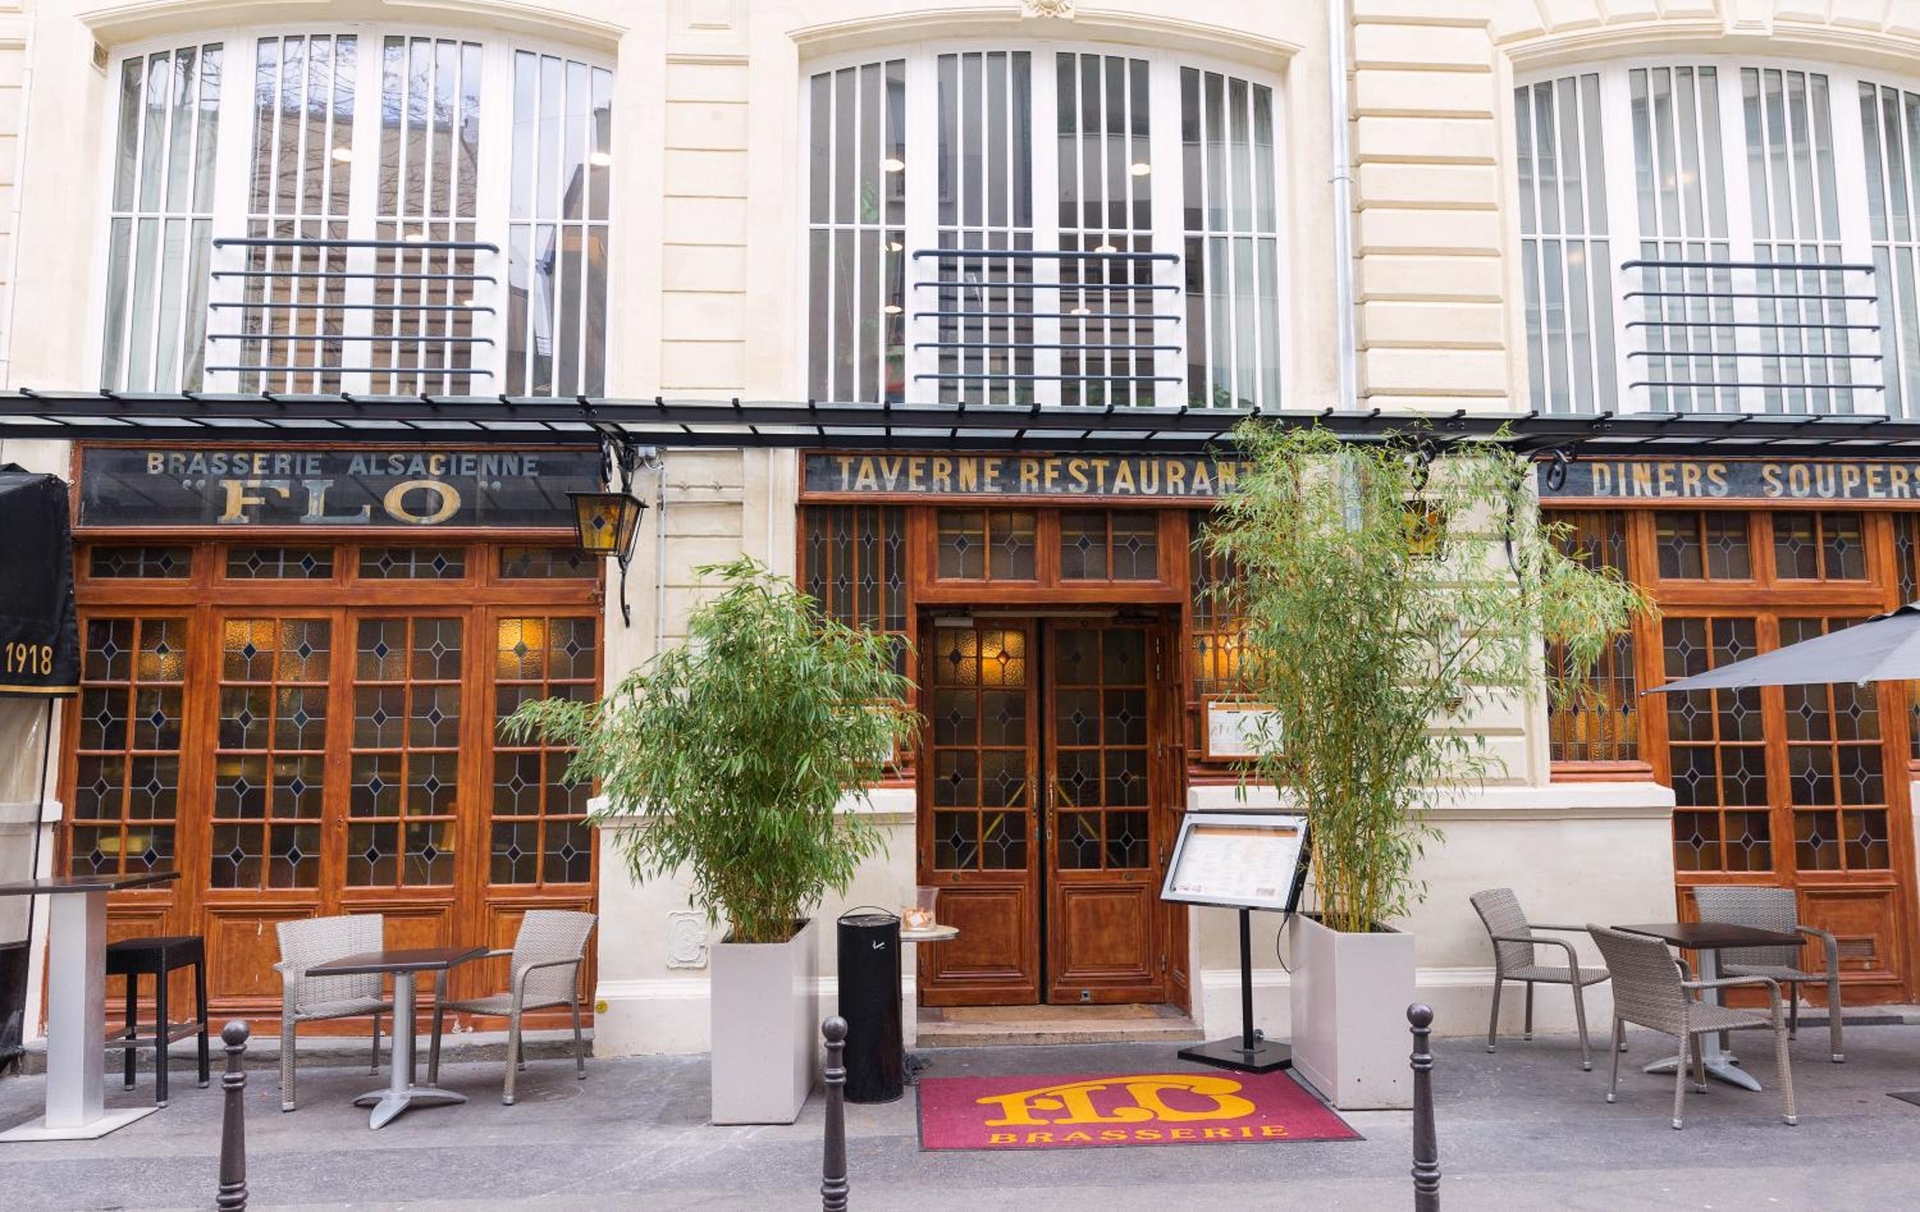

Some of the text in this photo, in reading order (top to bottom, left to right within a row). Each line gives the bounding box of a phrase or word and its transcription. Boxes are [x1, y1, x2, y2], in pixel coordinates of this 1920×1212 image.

[146, 452, 540, 477] BRASSERIE ALSACIENNE
[837, 456, 1003, 492] TAVERNE
[1591, 462, 1920, 499] DINERS SOUPER
[5, 642, 53, 675] 1918
[975, 1074, 1257, 1126] FLO
[987, 1124, 1290, 1145] BRASSERIE
